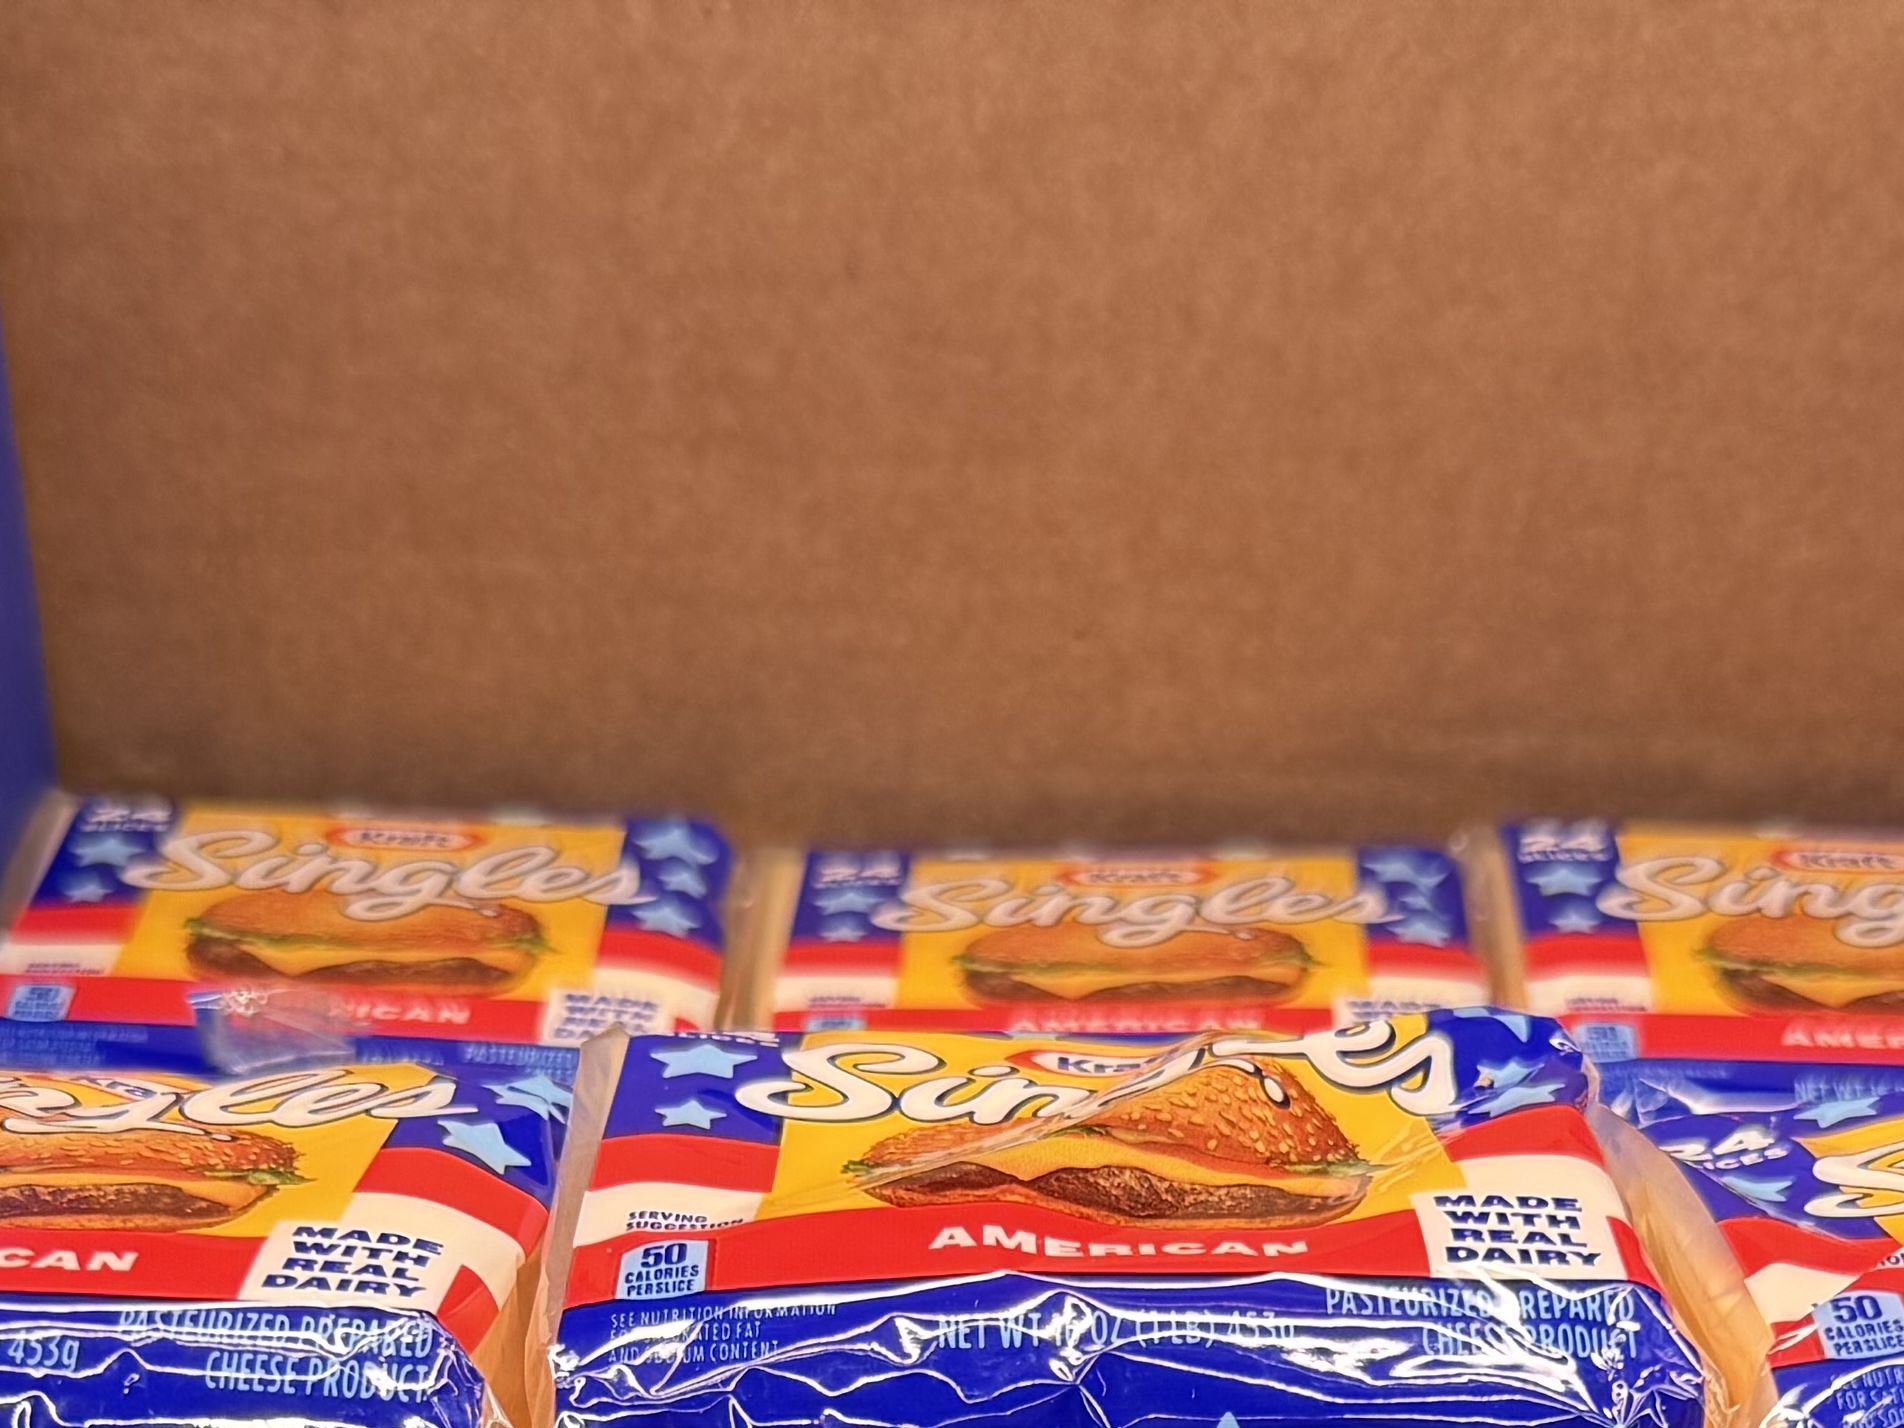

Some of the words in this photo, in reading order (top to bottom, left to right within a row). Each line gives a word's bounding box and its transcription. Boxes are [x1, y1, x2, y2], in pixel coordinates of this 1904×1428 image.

[120, 829, 656, 921] Singles
[871, 877, 1403, 948] Singles
[1433, 1194, 1583, 1212] MADE
[628, 1210, 707, 1222] SERVING
[1443, 1210, 1581, 1230] WITH
[292, 1226, 445, 1255] MADE
[929, 1224, 1308, 1257] AMERICAN
[1450, 1228, 1587, 1248] REAL
[294, 1241, 431, 1267] WITH
[640, 1242, 687, 1268] 50
[1446, 1246, 1602, 1266] DAIRY
[282, 1257, 421, 1282] REAL
[625, 1265, 700, 1284] CALORIES
[262, 1273, 428, 1298] DAIRY
[611, 1313, 635, 1327] SEE
[641, 1306, 722, 1326] NUTRITION
[1832, 1294, 1883, 1324] 50
[736, 1321, 761, 1339] FAT
[995, 1312, 1039, 1350] WT
[1824, 1320, 1904, 1343] CALORIES
[7, 1331, 80, 1371] 453g
[710, 1340, 778, 1362] CONTENT
[206, 1350, 299, 1394] CHEESE
[1836, 1390, 1866, 1411] FOR
